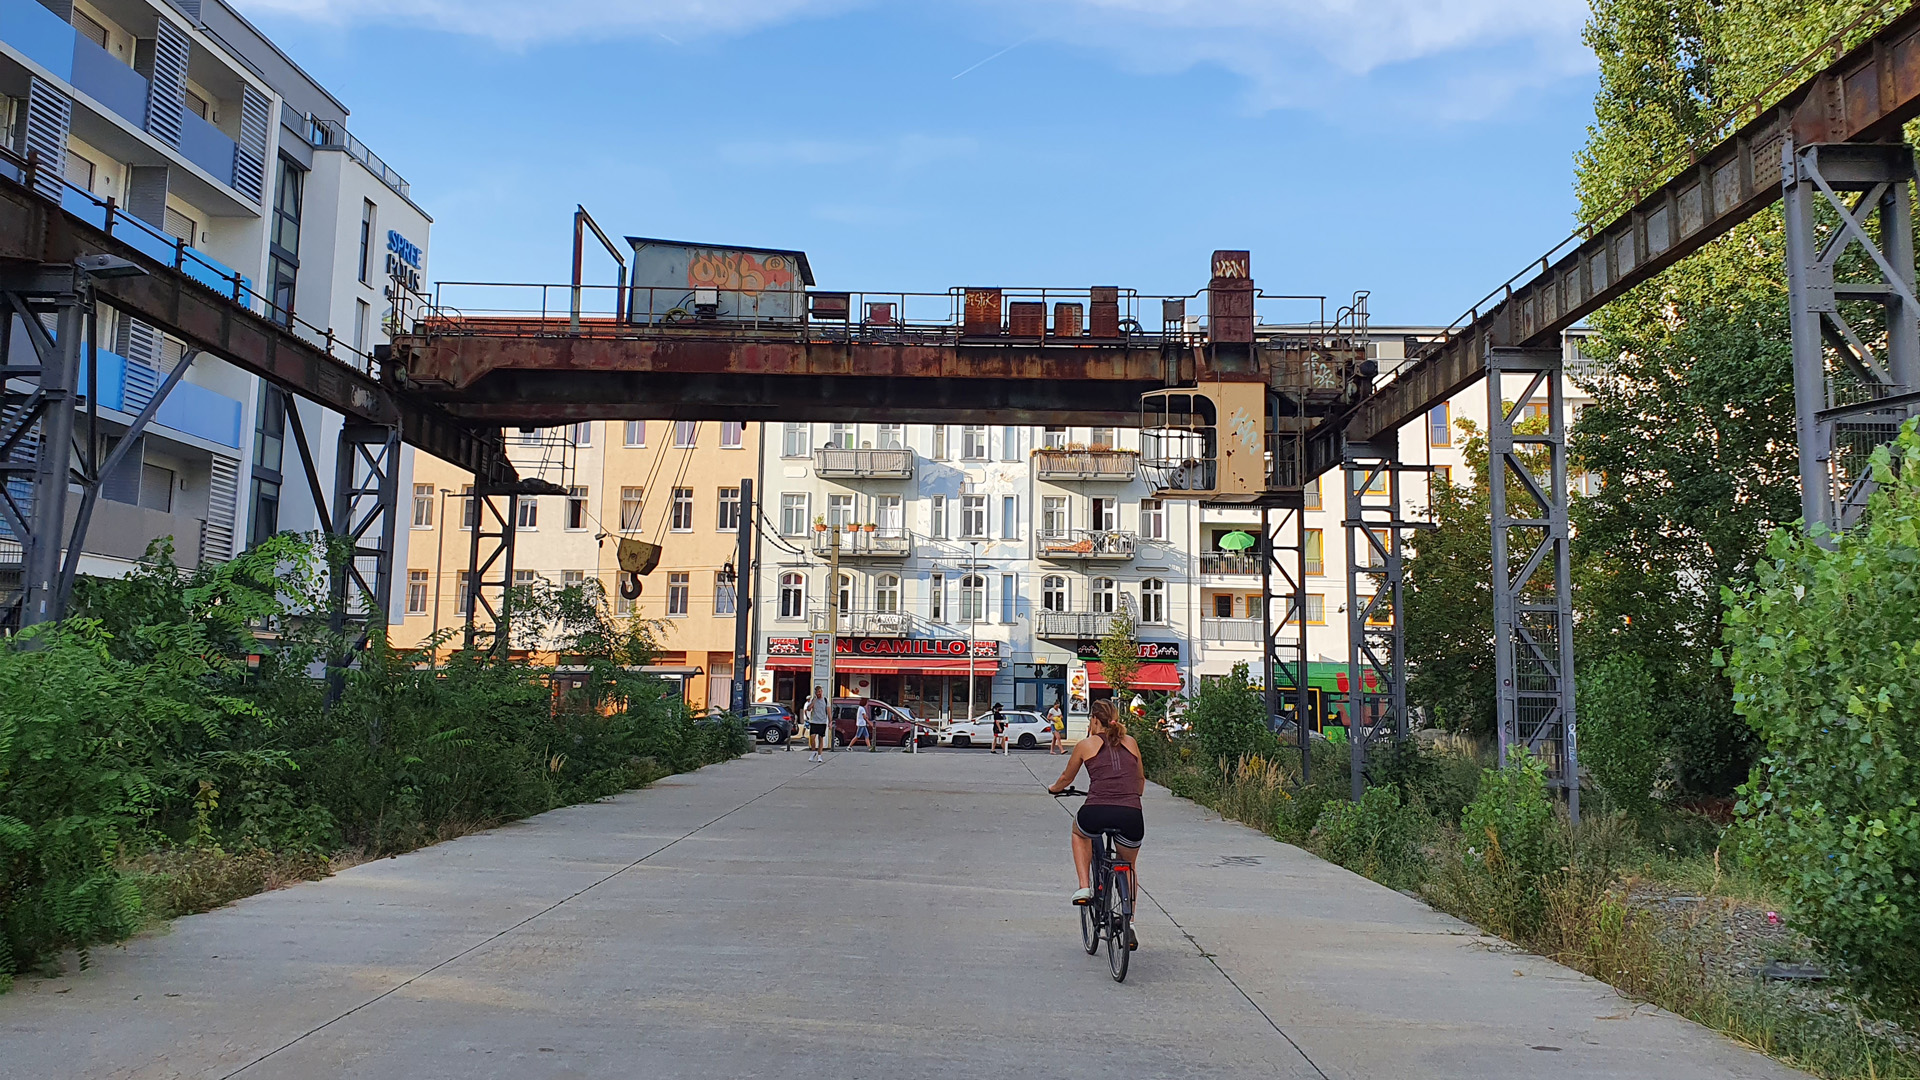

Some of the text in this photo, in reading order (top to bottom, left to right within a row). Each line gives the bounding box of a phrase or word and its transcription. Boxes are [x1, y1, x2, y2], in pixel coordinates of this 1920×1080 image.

[387, 230, 422, 271] SPREE
[803, 638, 966, 655] DN CAMILLO
[967, 640, 998, 648] PZZERIA
